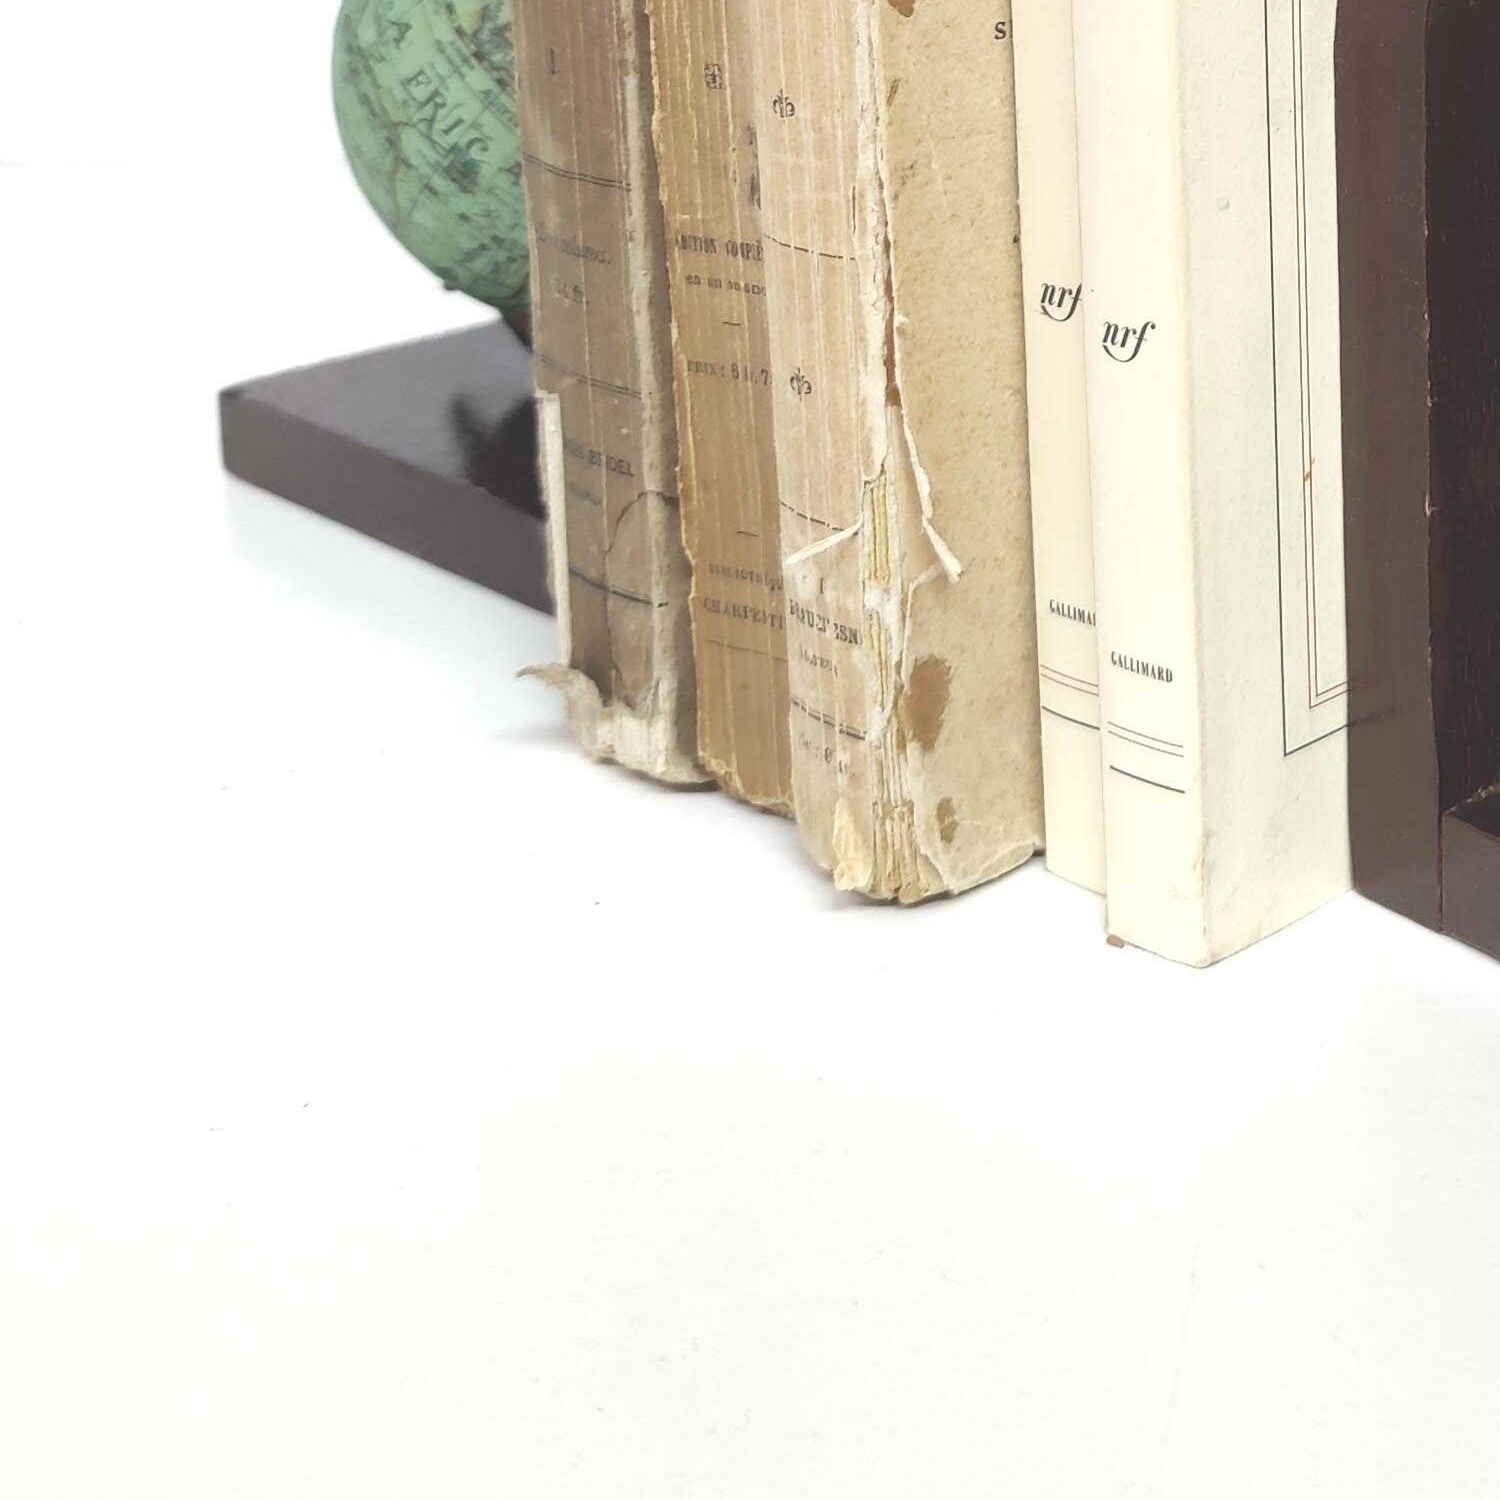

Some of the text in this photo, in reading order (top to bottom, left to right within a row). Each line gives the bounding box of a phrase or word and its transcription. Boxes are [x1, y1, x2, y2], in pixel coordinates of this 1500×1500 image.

[1102, 320, 1156, 363] nrf
[1049, 598, 1096, 627] GALLIMA
[1110, 650, 1174, 684] GALLIMARD
